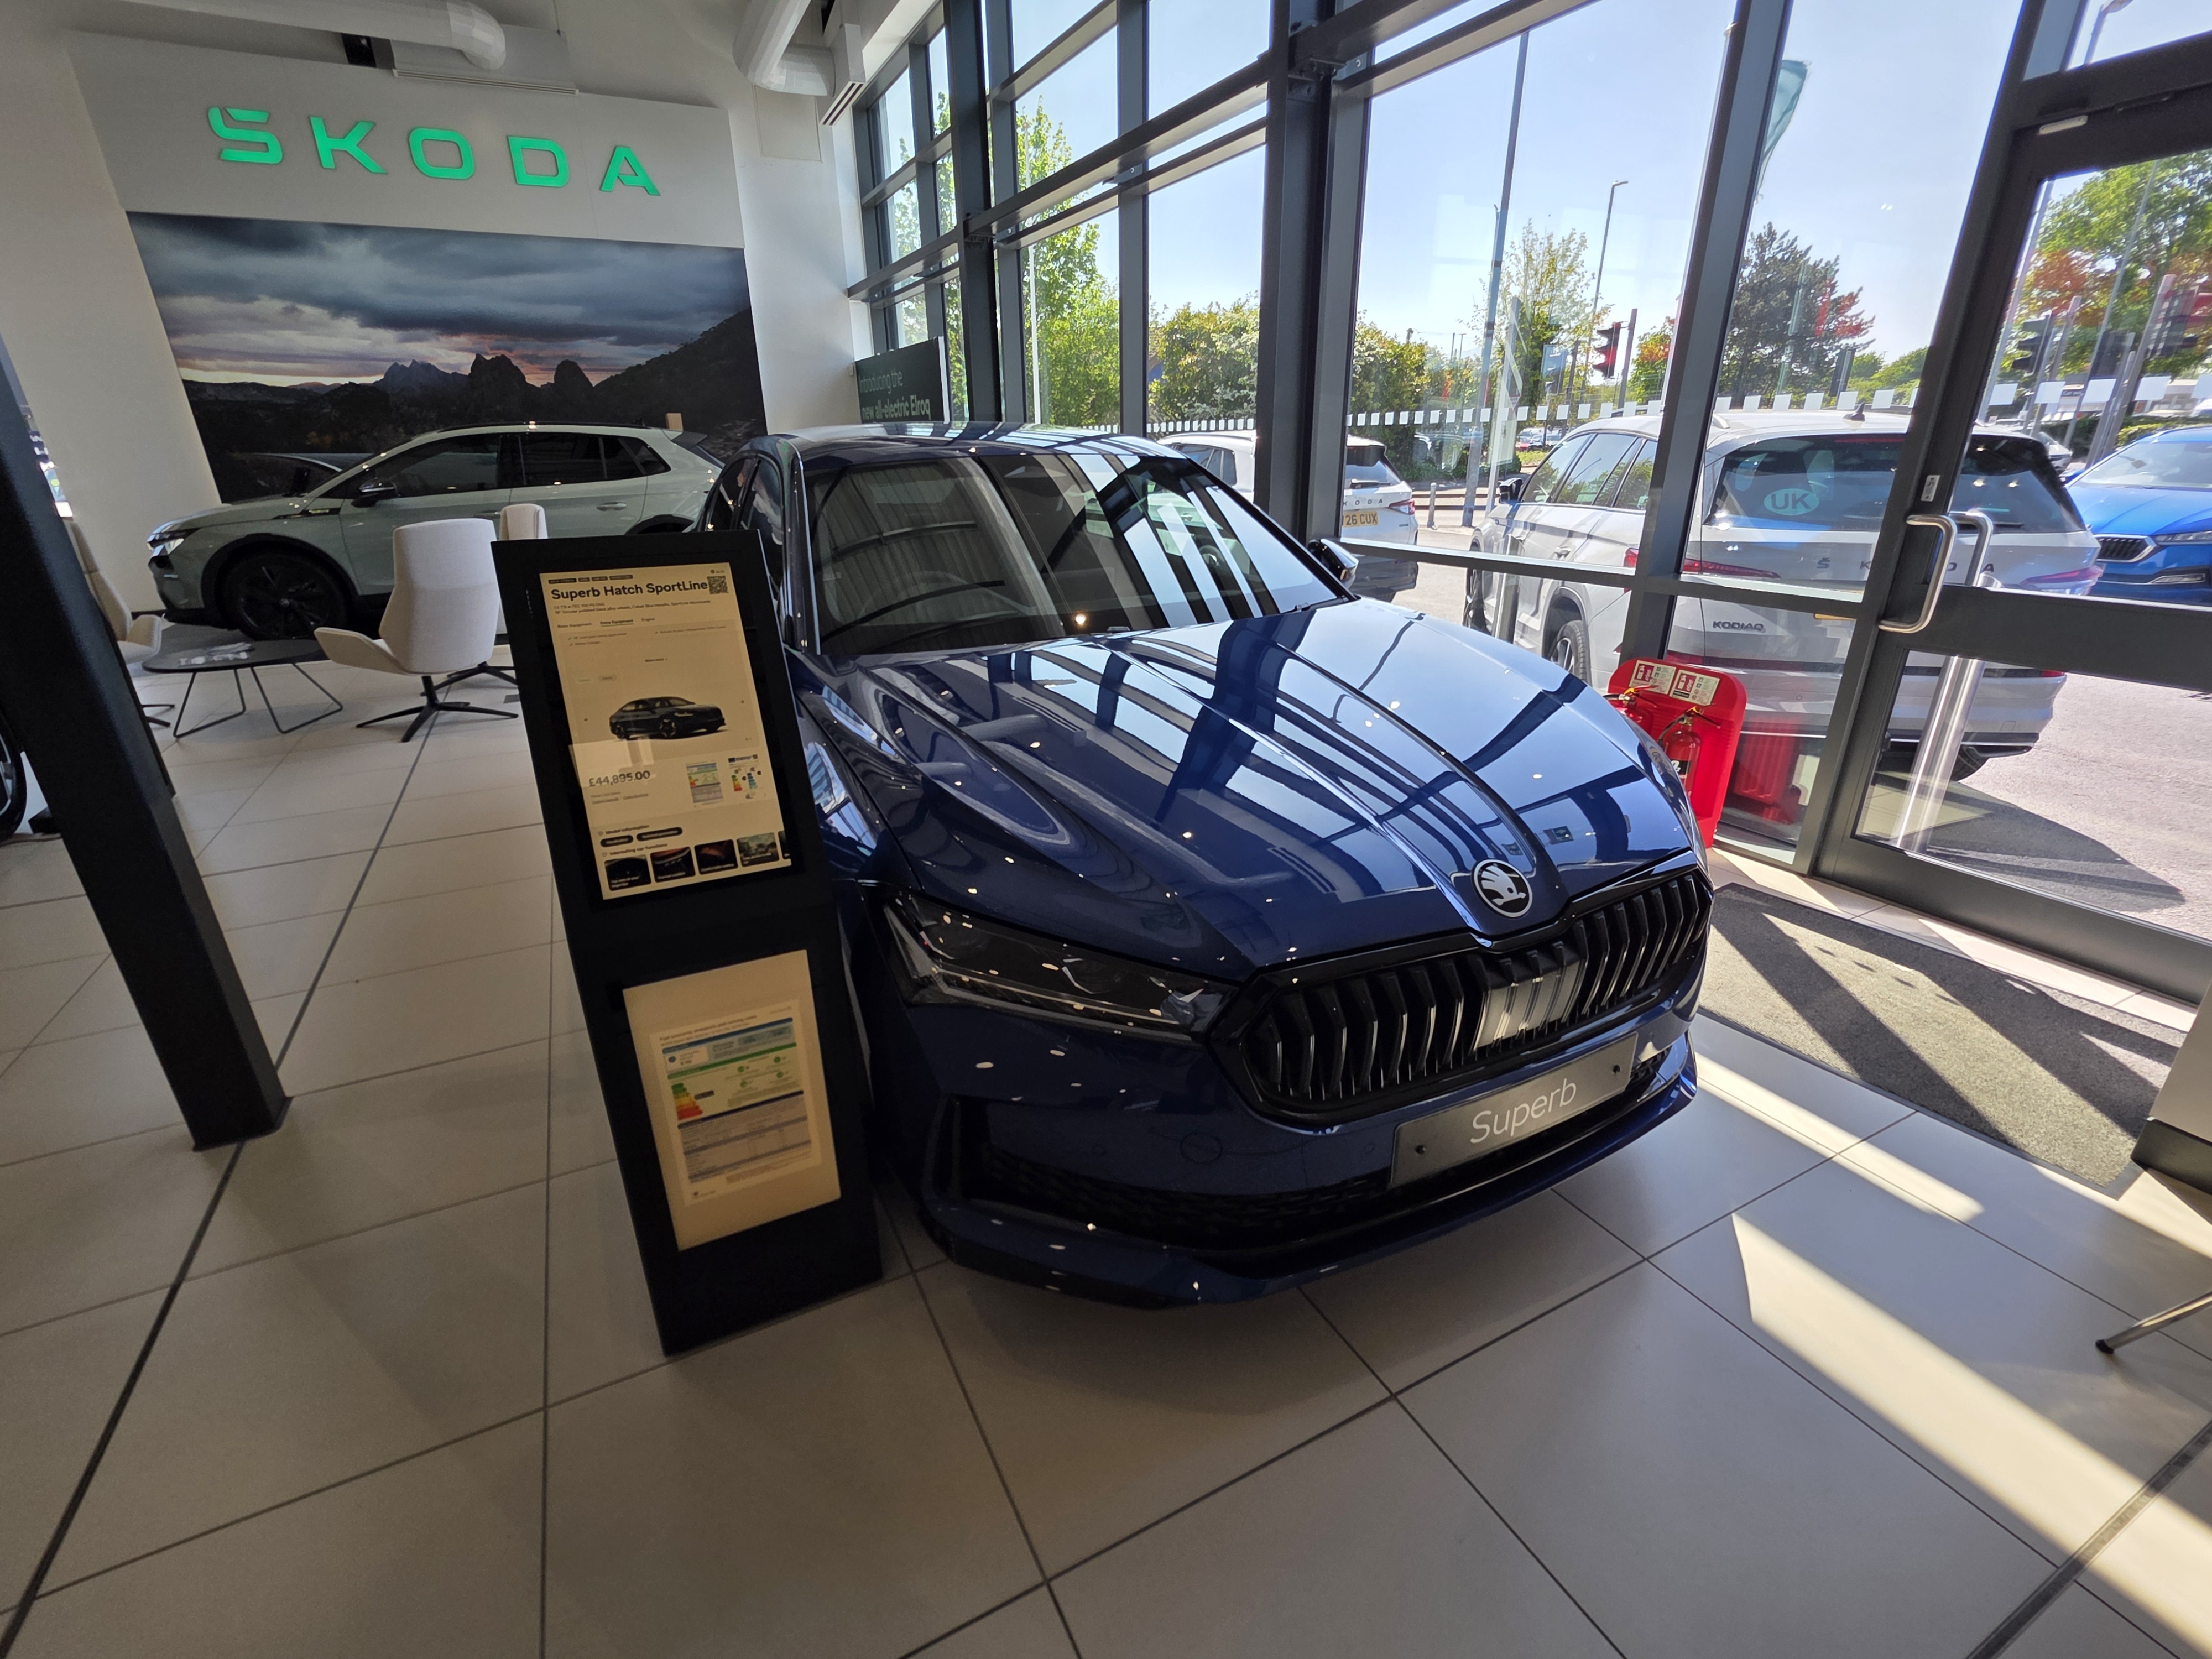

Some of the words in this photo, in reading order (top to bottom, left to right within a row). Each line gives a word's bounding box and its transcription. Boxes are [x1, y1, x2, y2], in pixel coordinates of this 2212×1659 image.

[891, 367, 904, 388] the
[862, 406, 874, 420] new
[875, 395, 910, 419] all-electric
[910, 394, 931, 421] Elroq
[1771, 493, 1811, 510] UK
[1342, 514, 1358, 526] 26
[1359, 513, 1378, 525] CUX
[551, 587, 601, 601] Superb
[603, 584, 643, 597] Hatch
[646, 581, 708, 596] SportLine
[1713, 621, 1766, 633] KODIAQ
[589, 770, 650, 787] £44,895.00
[1470, 1078, 1577, 1144] Superb
